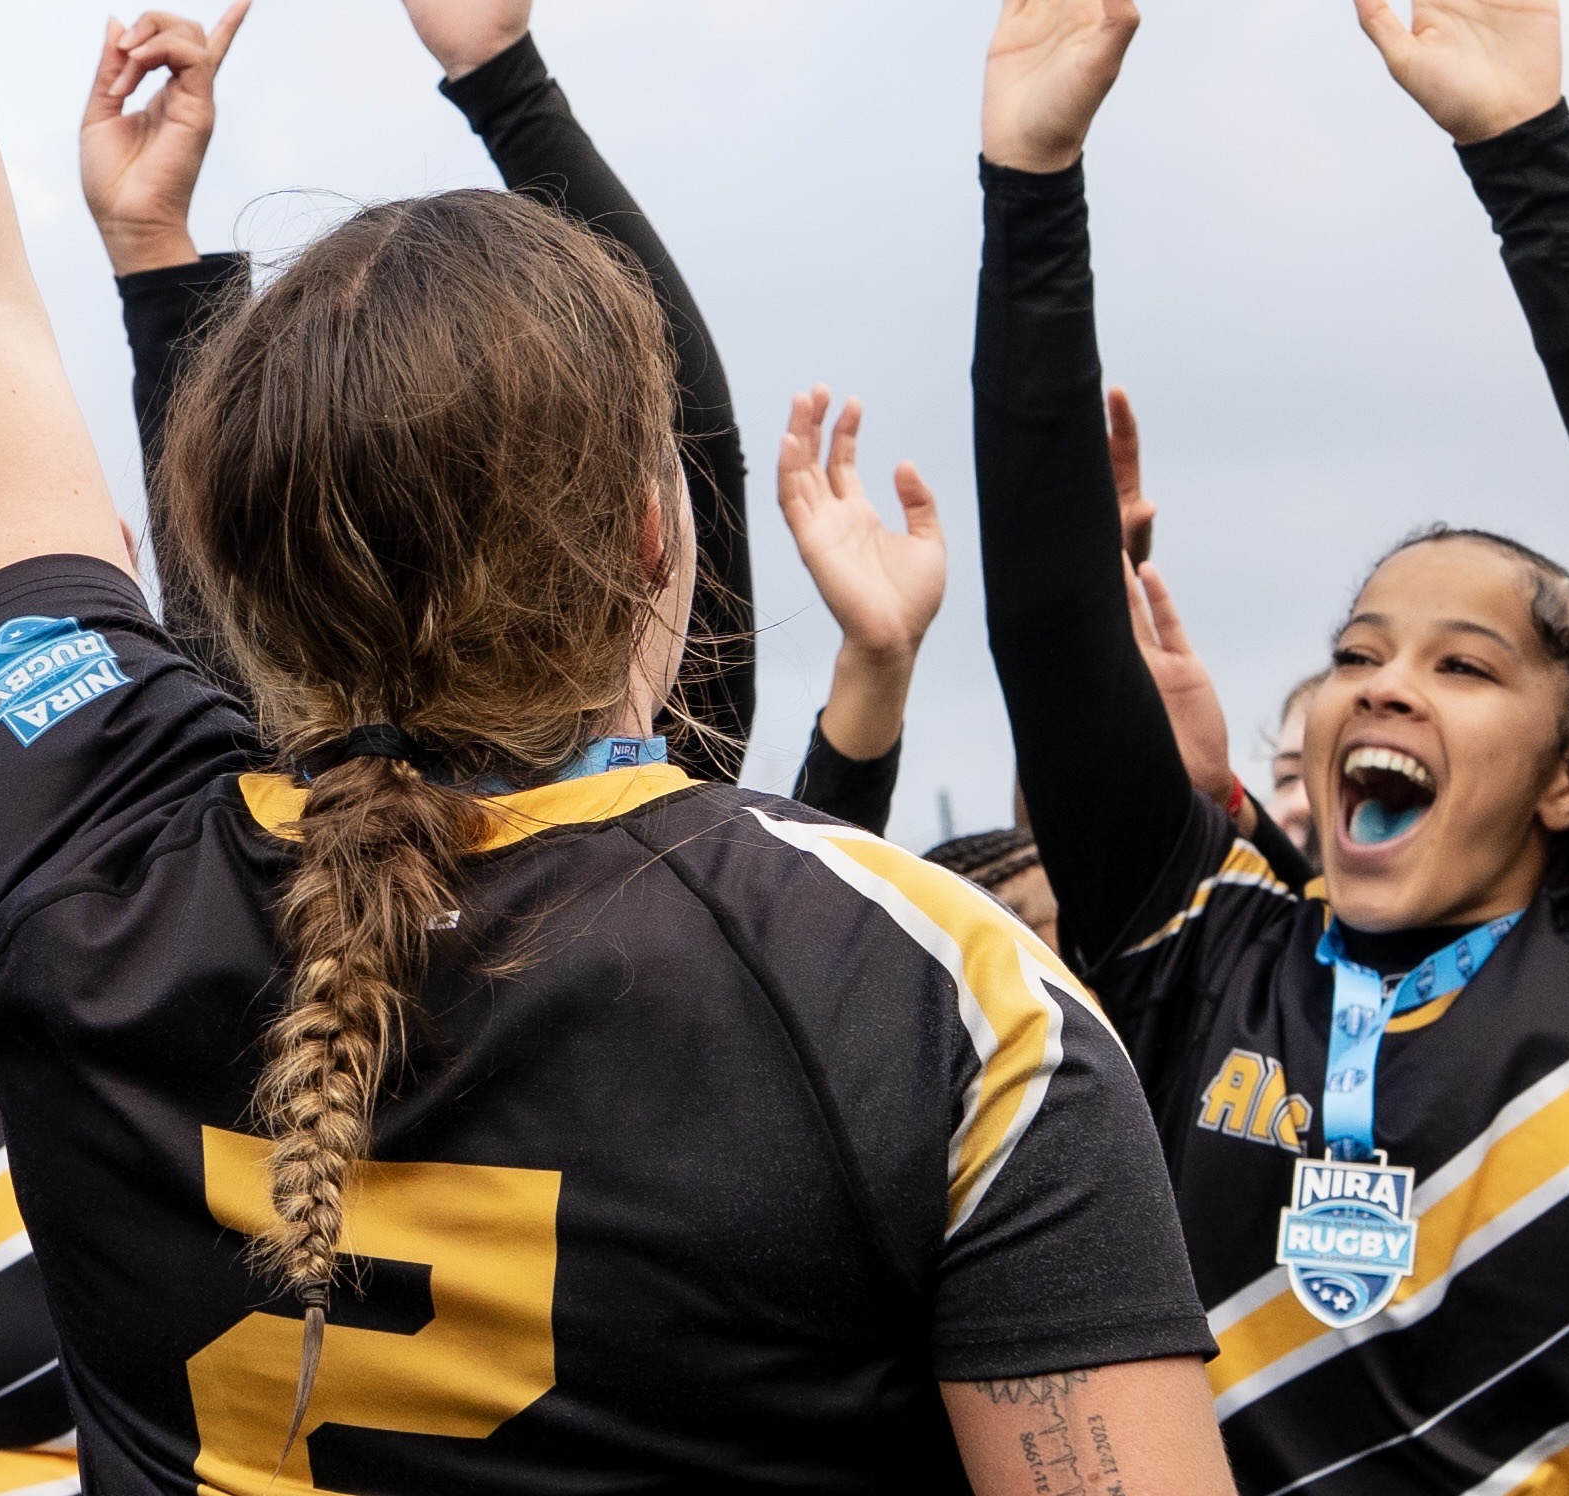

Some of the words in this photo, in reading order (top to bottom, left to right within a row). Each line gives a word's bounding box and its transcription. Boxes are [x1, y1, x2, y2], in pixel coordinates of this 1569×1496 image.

[13, 661, 120, 728] NIRA
[613, 745, 636, 758] NIRA
[1197, 1047, 1313, 1154] AIC
[1301, 1167, 1399, 1214] NIRA
[1288, 1224, 1408, 1260] RUGBY
